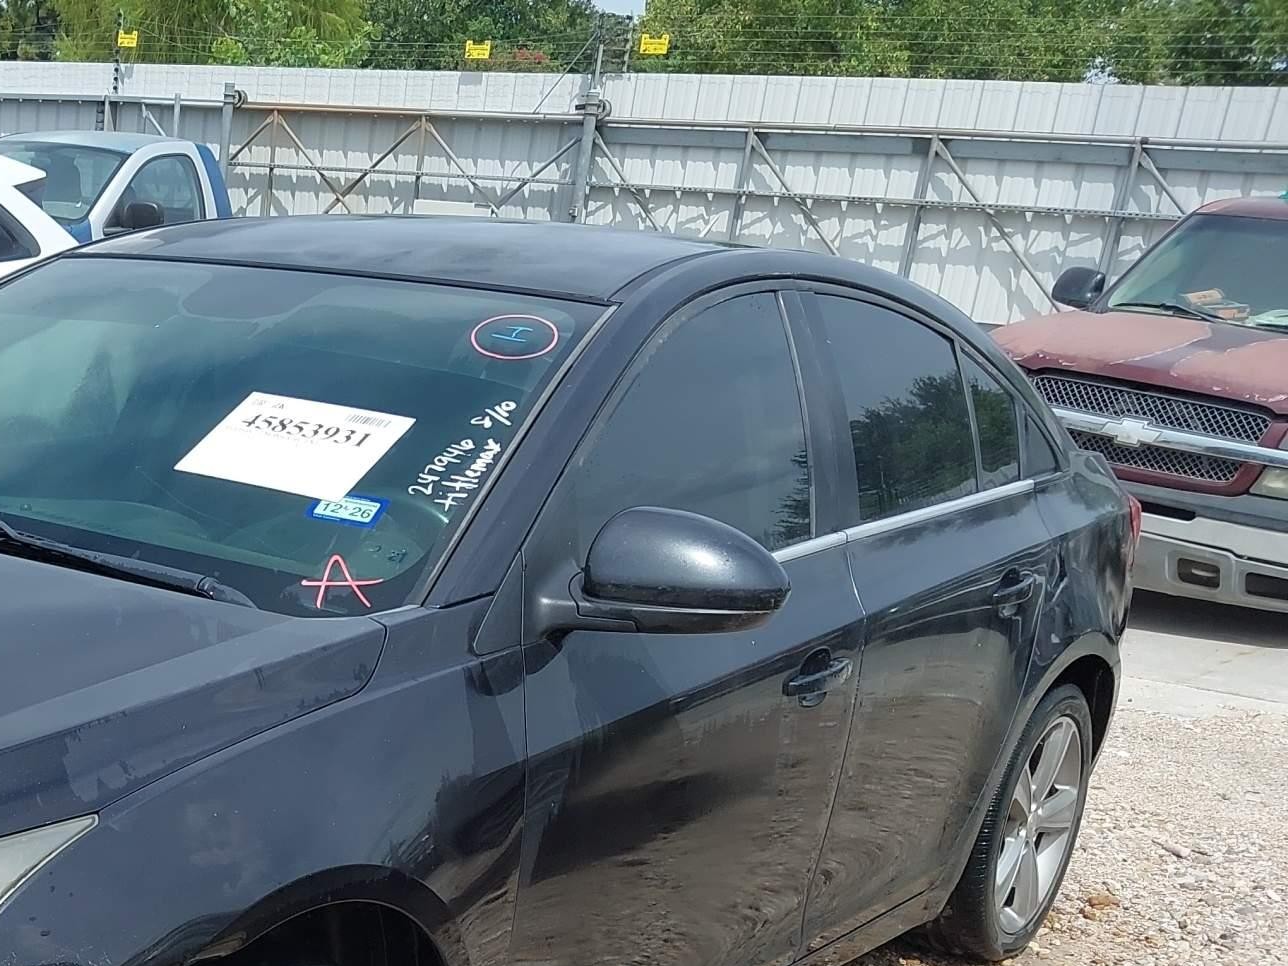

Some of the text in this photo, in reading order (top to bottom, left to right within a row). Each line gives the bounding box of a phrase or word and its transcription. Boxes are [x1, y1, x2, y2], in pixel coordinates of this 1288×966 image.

[241, 413, 373, 447] 45853931
[322, 501, 342, 514] 12
[349, 506, 374, 519] 26
[301, 555, 384, 609] A
